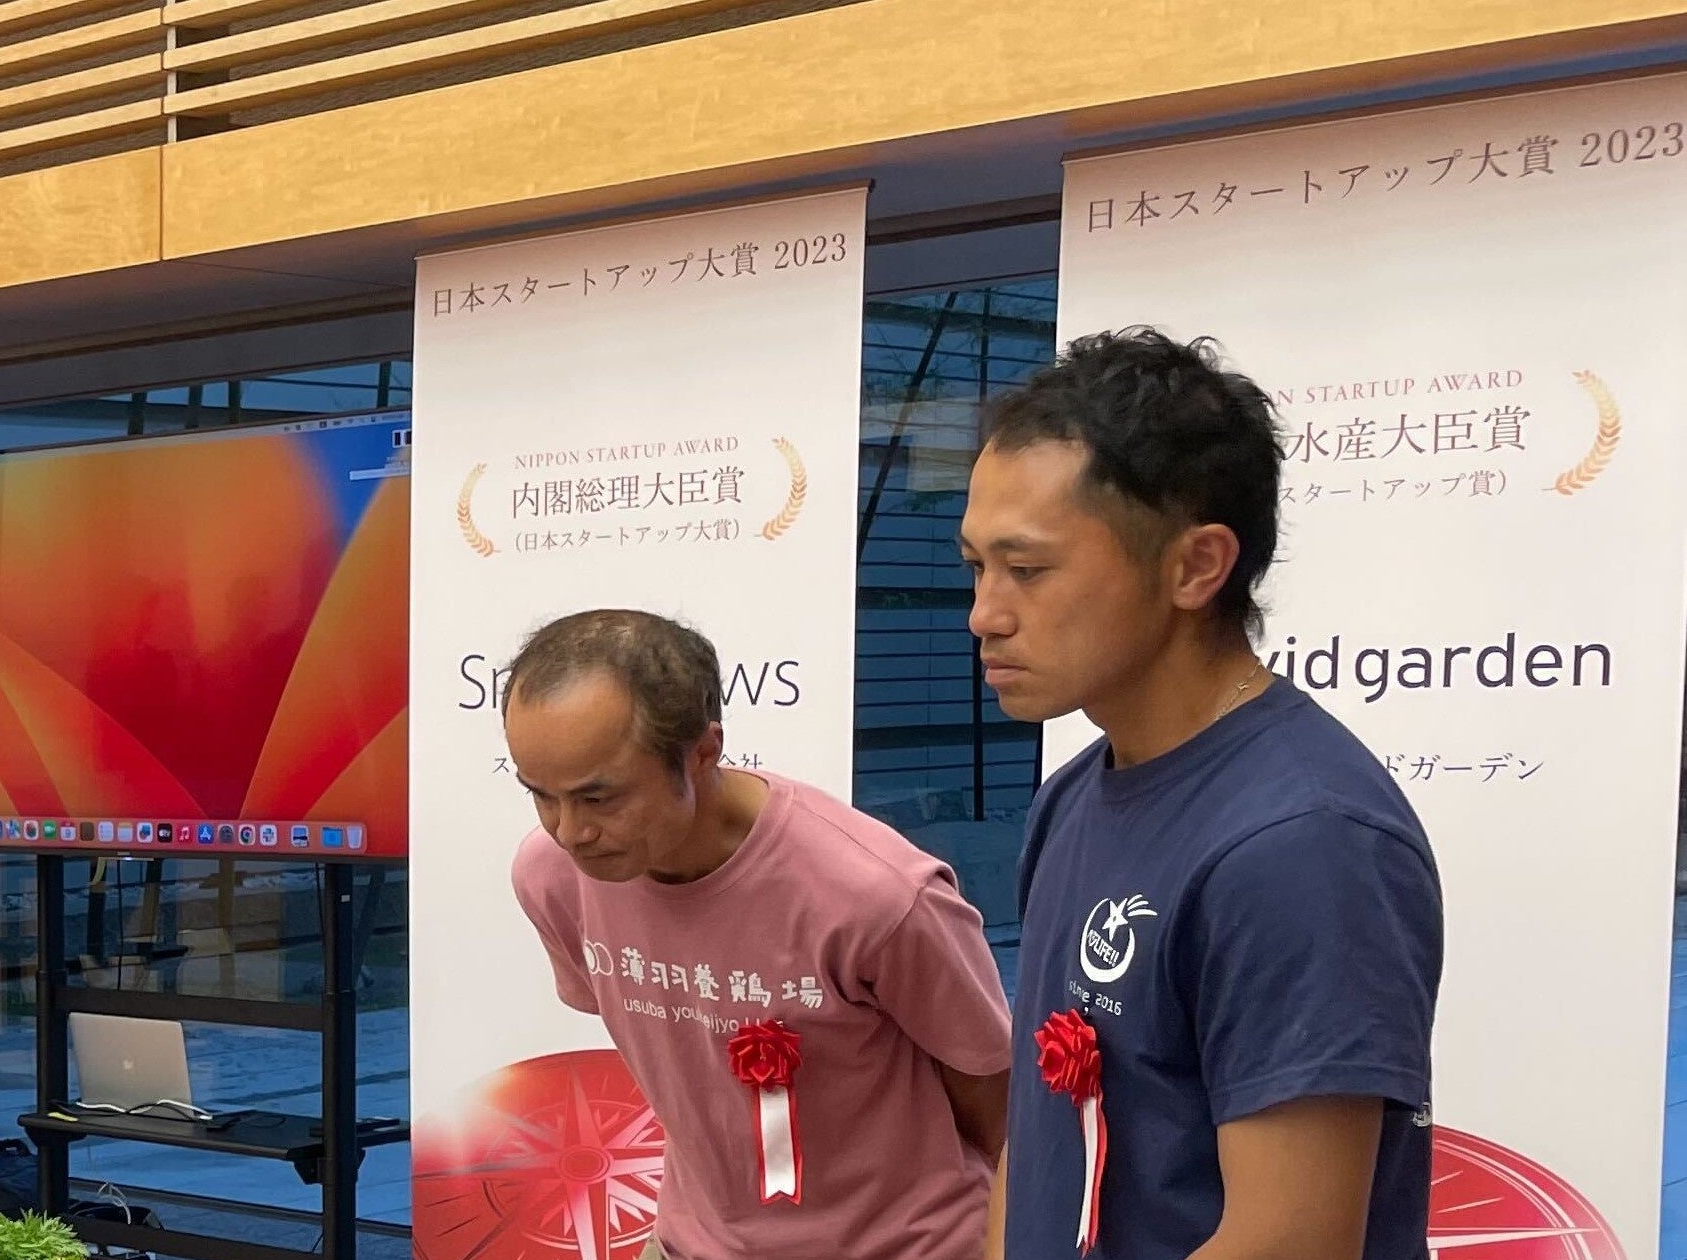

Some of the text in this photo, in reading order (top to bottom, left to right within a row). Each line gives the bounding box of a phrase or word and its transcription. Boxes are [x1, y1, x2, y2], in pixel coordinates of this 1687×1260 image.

[1088, 120, 1685, 233] 日本スタートアップ大賞 2023
[433, 232, 848, 318] 日本スタートアップ大賞 2023
[1306, 378, 1415, 405] STARTUP
[1428, 370, 1523, 394] AWARD
[515, 435, 739, 470] NIPPON STARTUP AWARD
[512, 465, 745, 520] 内閣総理大臣賞
[515, 518, 740, 552] (日本スタートアップ大賞)
[1355, 632, 1612, 704] garden
[623, 998, 667, 1019] usuba
[1095, 993, 1123, 1016] 2016
